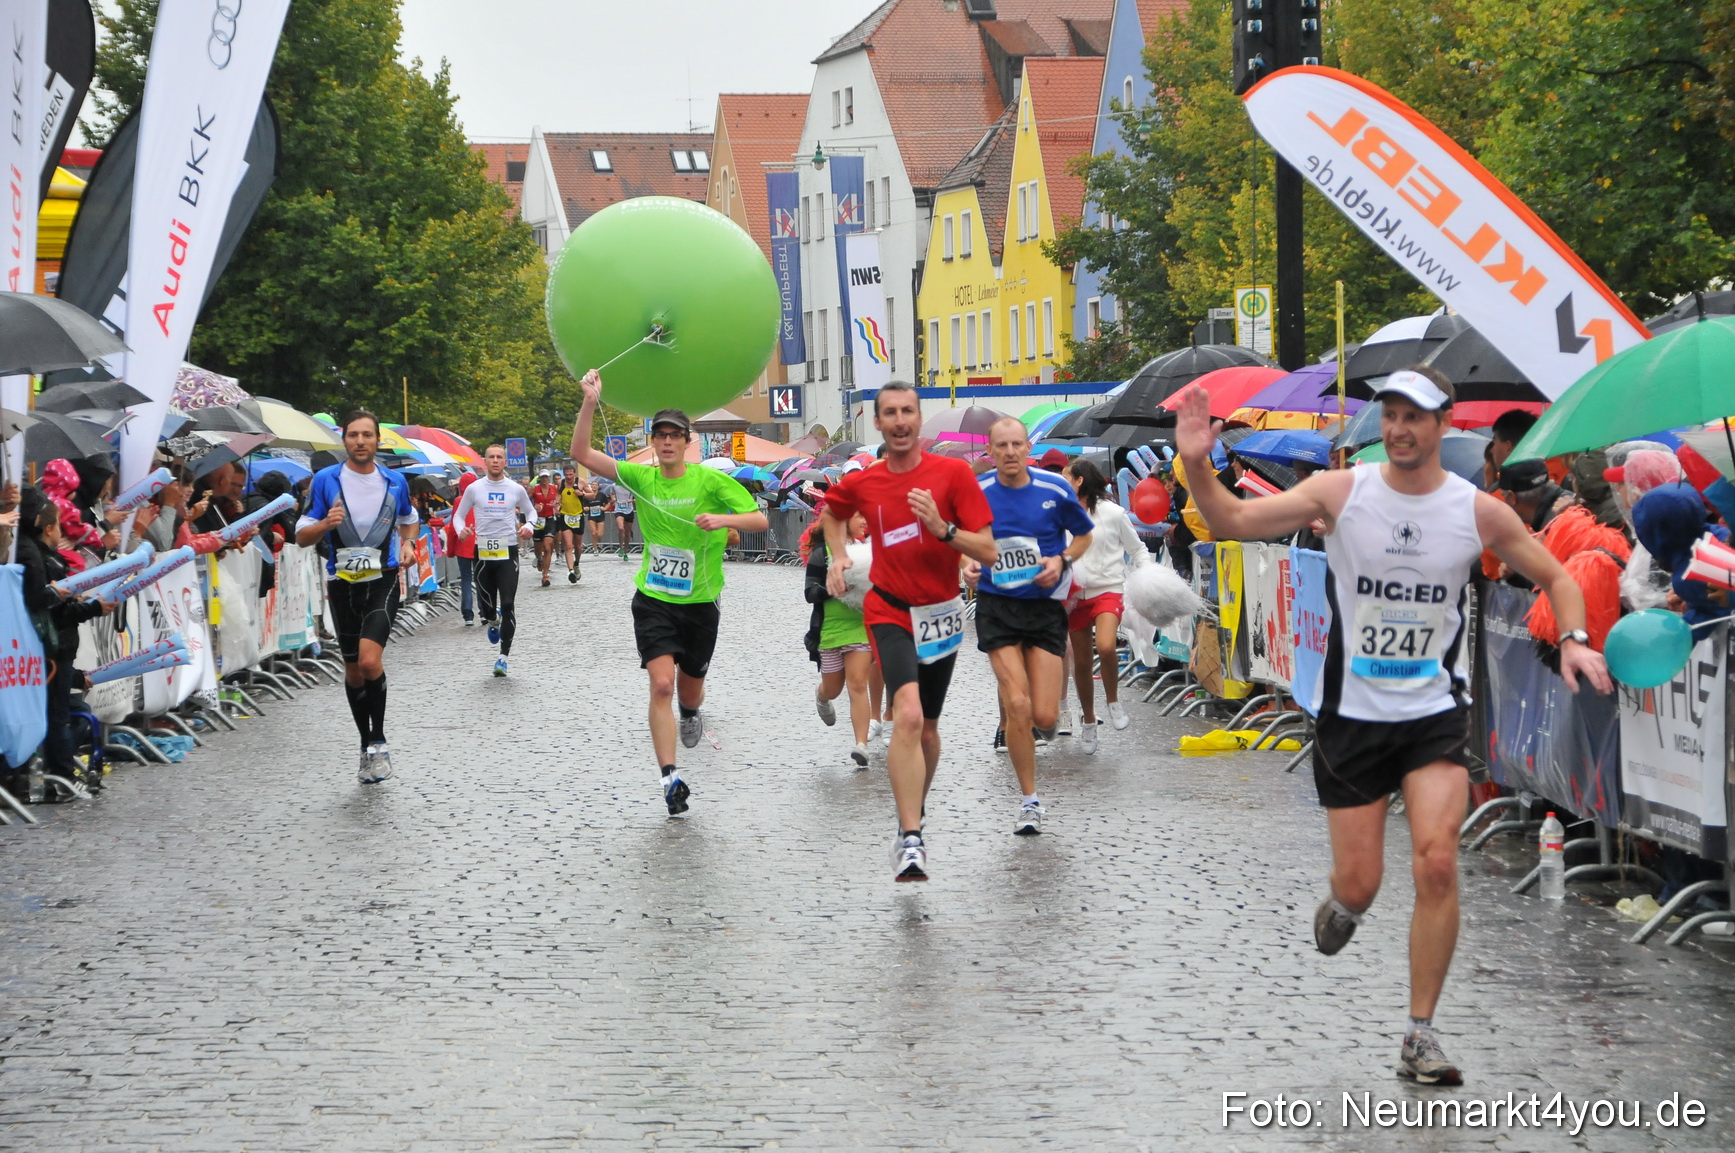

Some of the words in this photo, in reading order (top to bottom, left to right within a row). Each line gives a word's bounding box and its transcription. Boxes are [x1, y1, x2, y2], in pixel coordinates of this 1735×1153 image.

[152, 218, 192, 338] Audi
[178, 104, 216, 208] BKK
[954, 285, 974, 307] HOTEL
[1247, 297, 1261, 313] H
[508, 457, 526, 466] TAXI
[487, 539, 500, 551] 65
[345, 557, 371, 572] 270
[652, 556, 690, 579] 3278
[994, 549, 1038, 572] 3085
[1008, 571, 1028, 581] Peter
[919, 611, 963, 643] 2135
[1361, 624, 1435, 657] 3247
[1370, 661, 1421, 676] Christian
